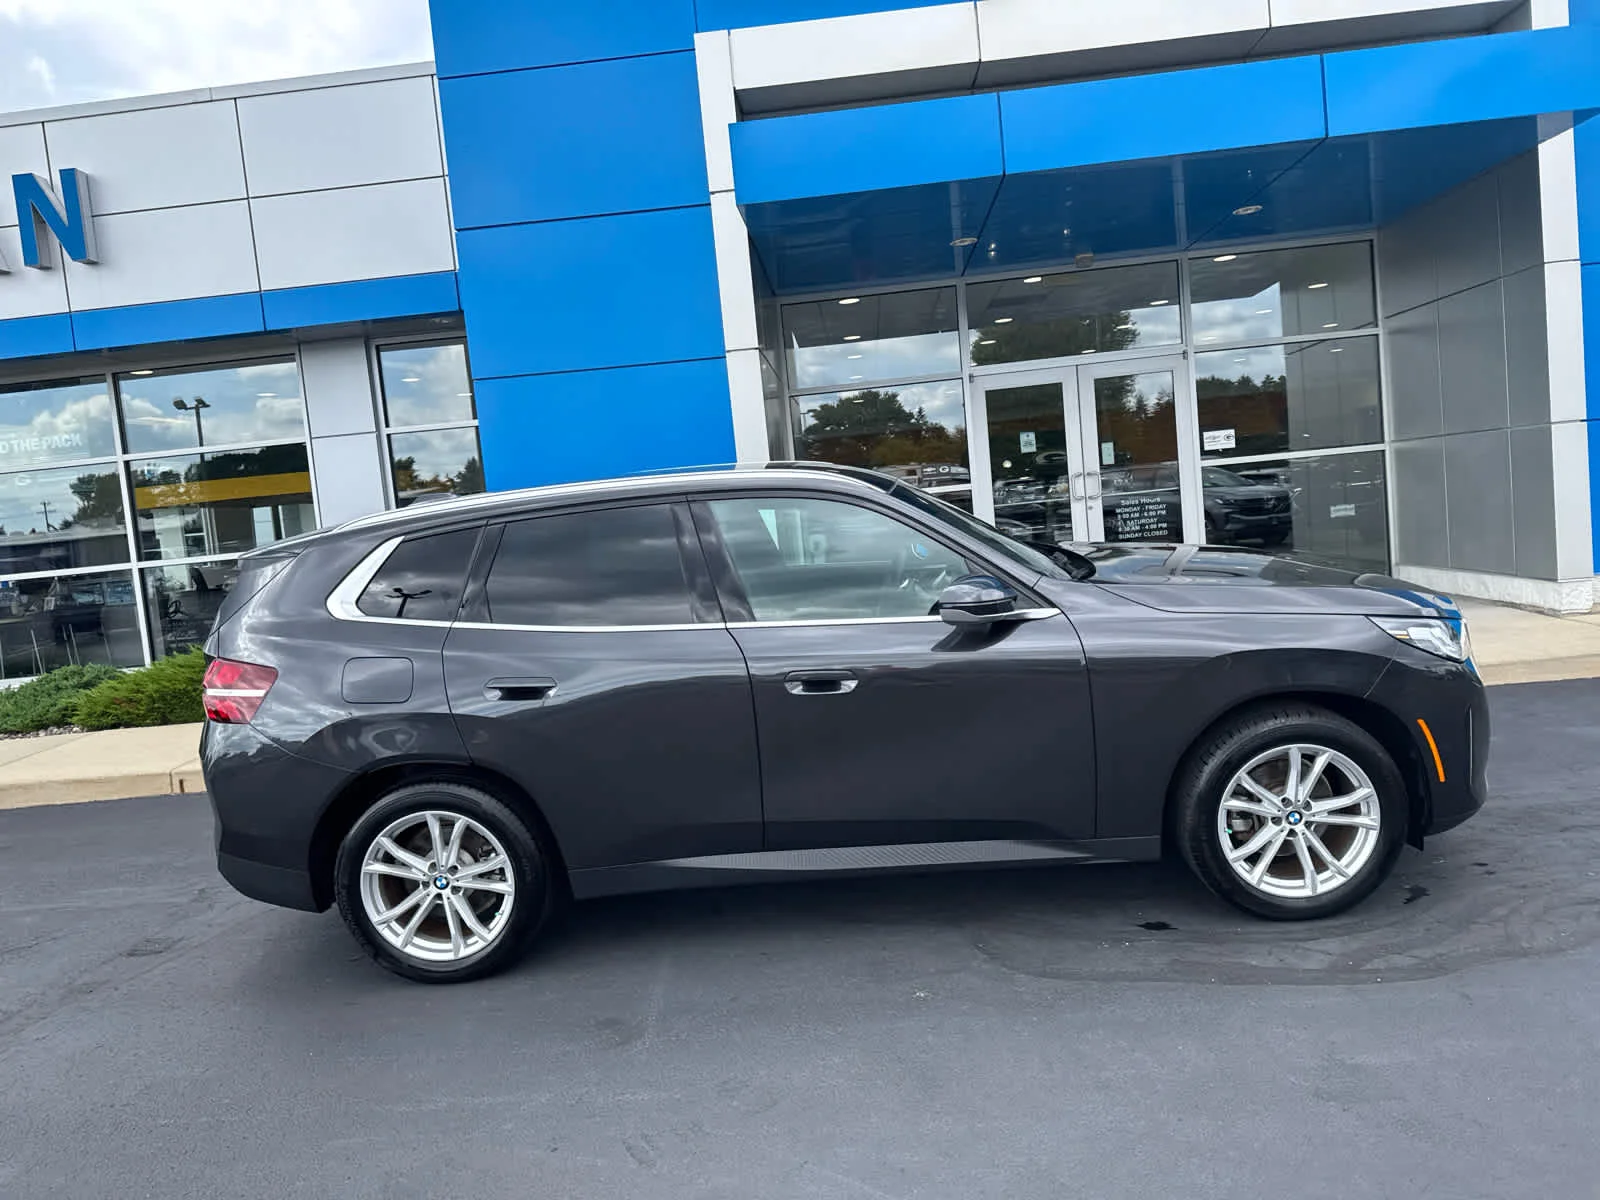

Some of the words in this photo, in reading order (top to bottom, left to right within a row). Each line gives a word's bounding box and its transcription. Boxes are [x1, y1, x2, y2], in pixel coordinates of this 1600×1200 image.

[11, 167, 99, 270] N
[10, 438, 40, 453] THE
[41, 433, 82, 450] PACK
[1126, 517, 1158, 526] SATURDAY
[1143, 529, 1169, 537] CLOSED
